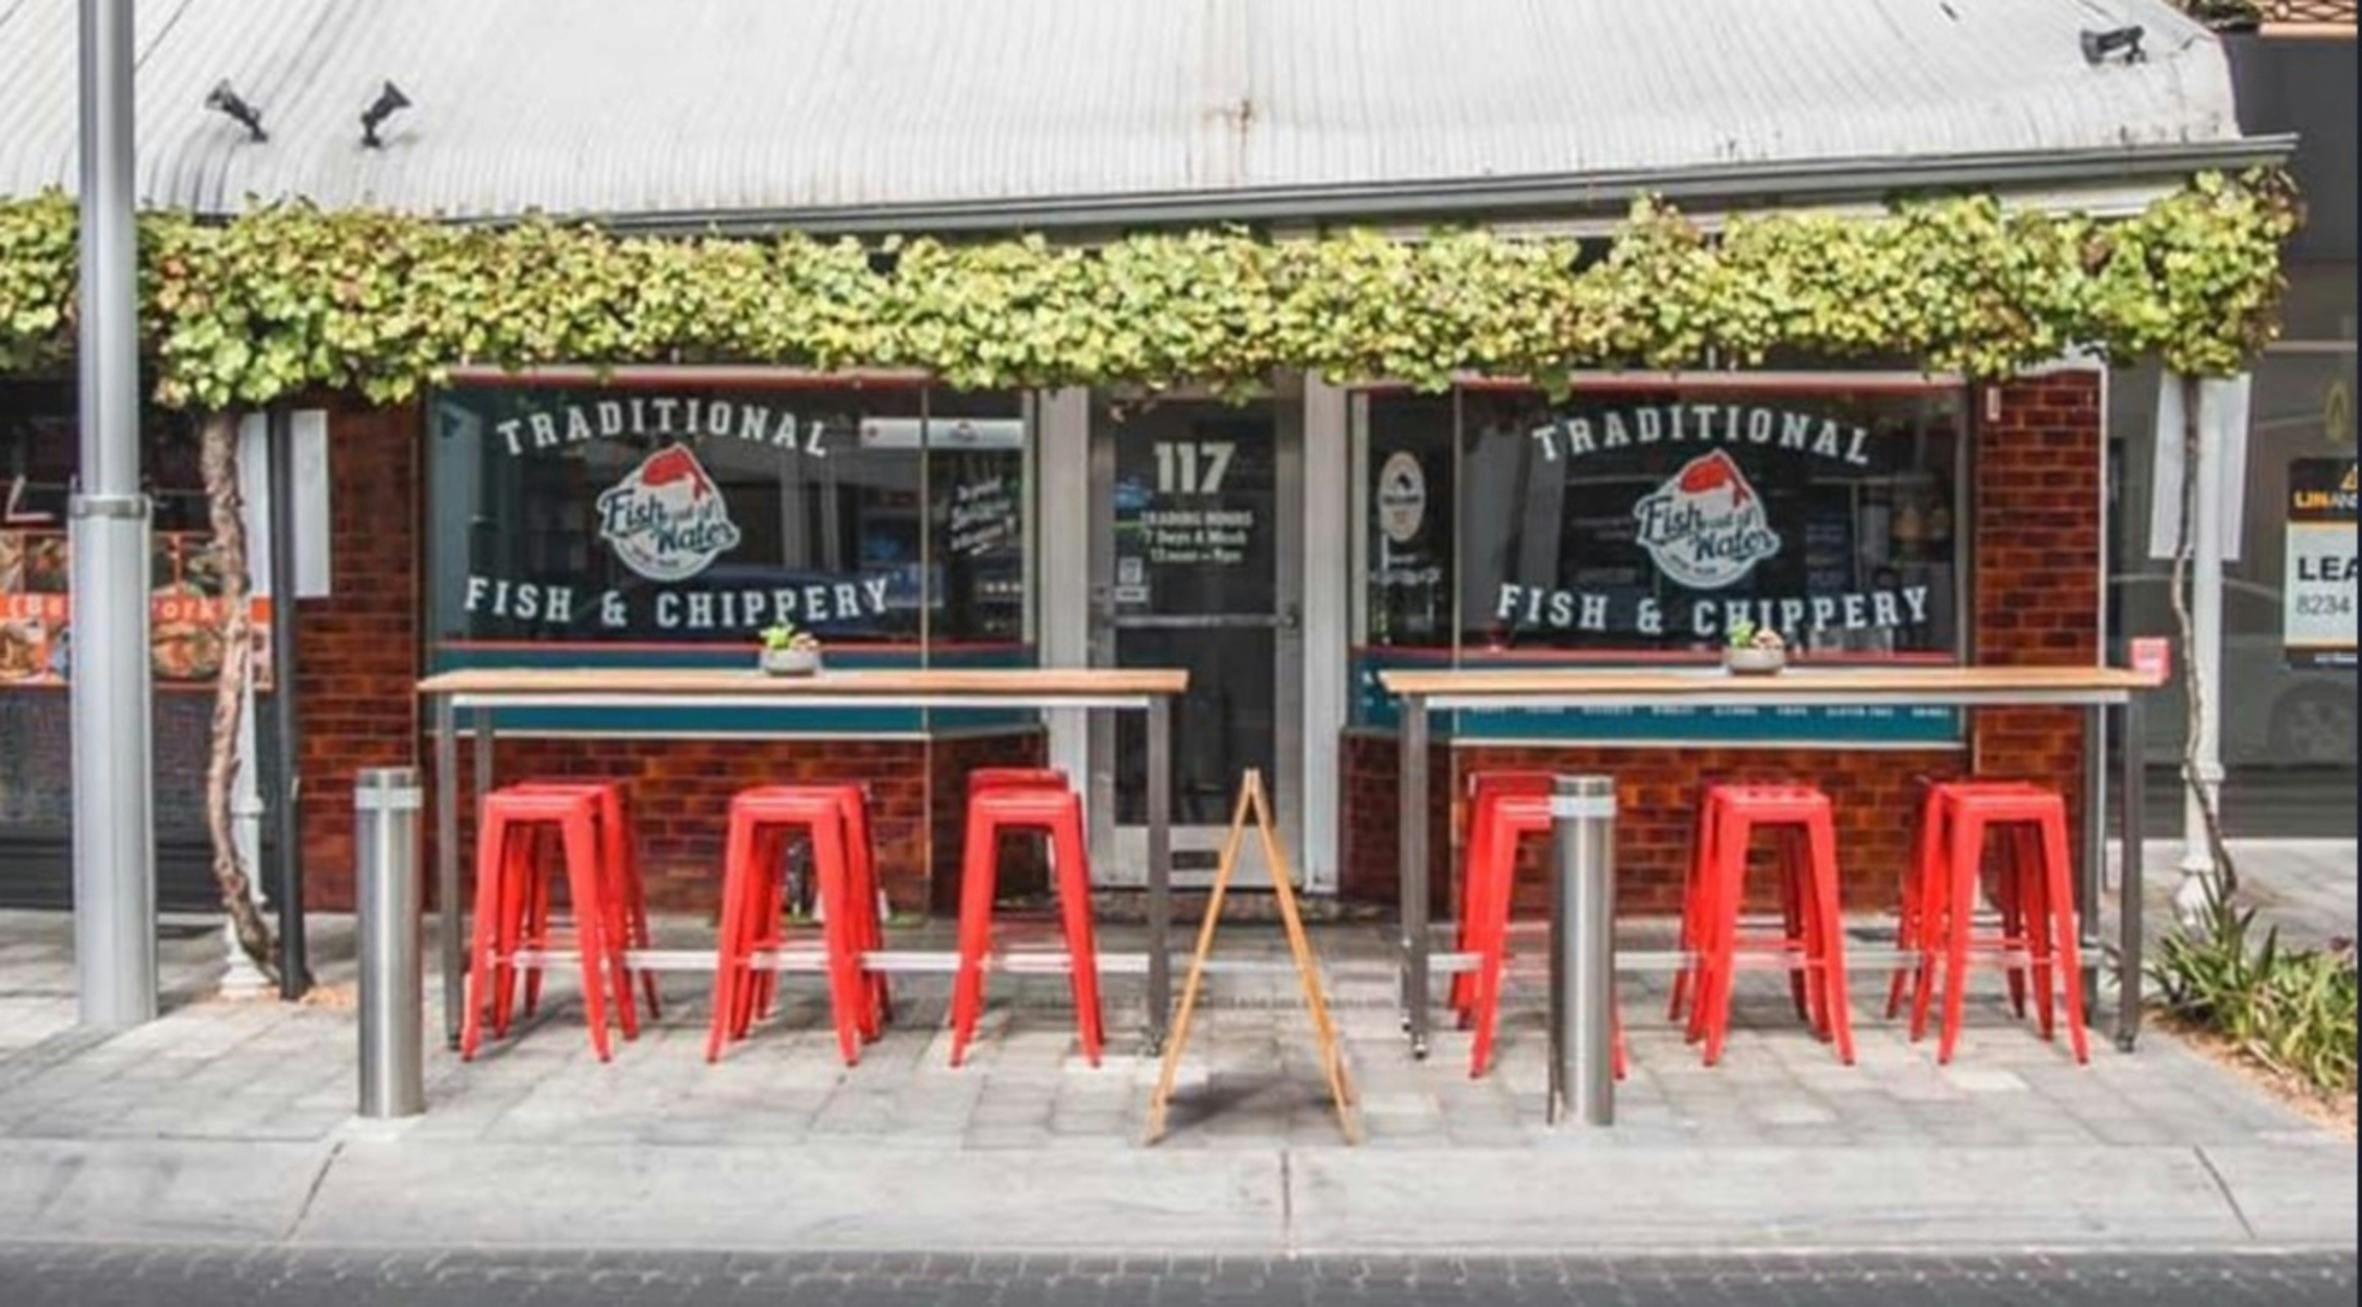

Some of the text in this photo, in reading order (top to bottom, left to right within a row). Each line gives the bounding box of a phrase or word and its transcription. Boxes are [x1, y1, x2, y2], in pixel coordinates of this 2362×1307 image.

[496, 398, 829, 458] TRADITIONAL
[1532, 404, 1870, 465] TRADITIONAL
[1153, 441, 1237, 493] 117
[600, 488, 668, 539] Fish
[647, 519, 738, 556] Water
[1638, 497, 1706, 547] Fish
[1687, 527, 1776, 561] Water
[464, 575, 890, 628] FISH & CHIPPERY
[1496, 584, 1929, 636] FISH & CHIPPERY
